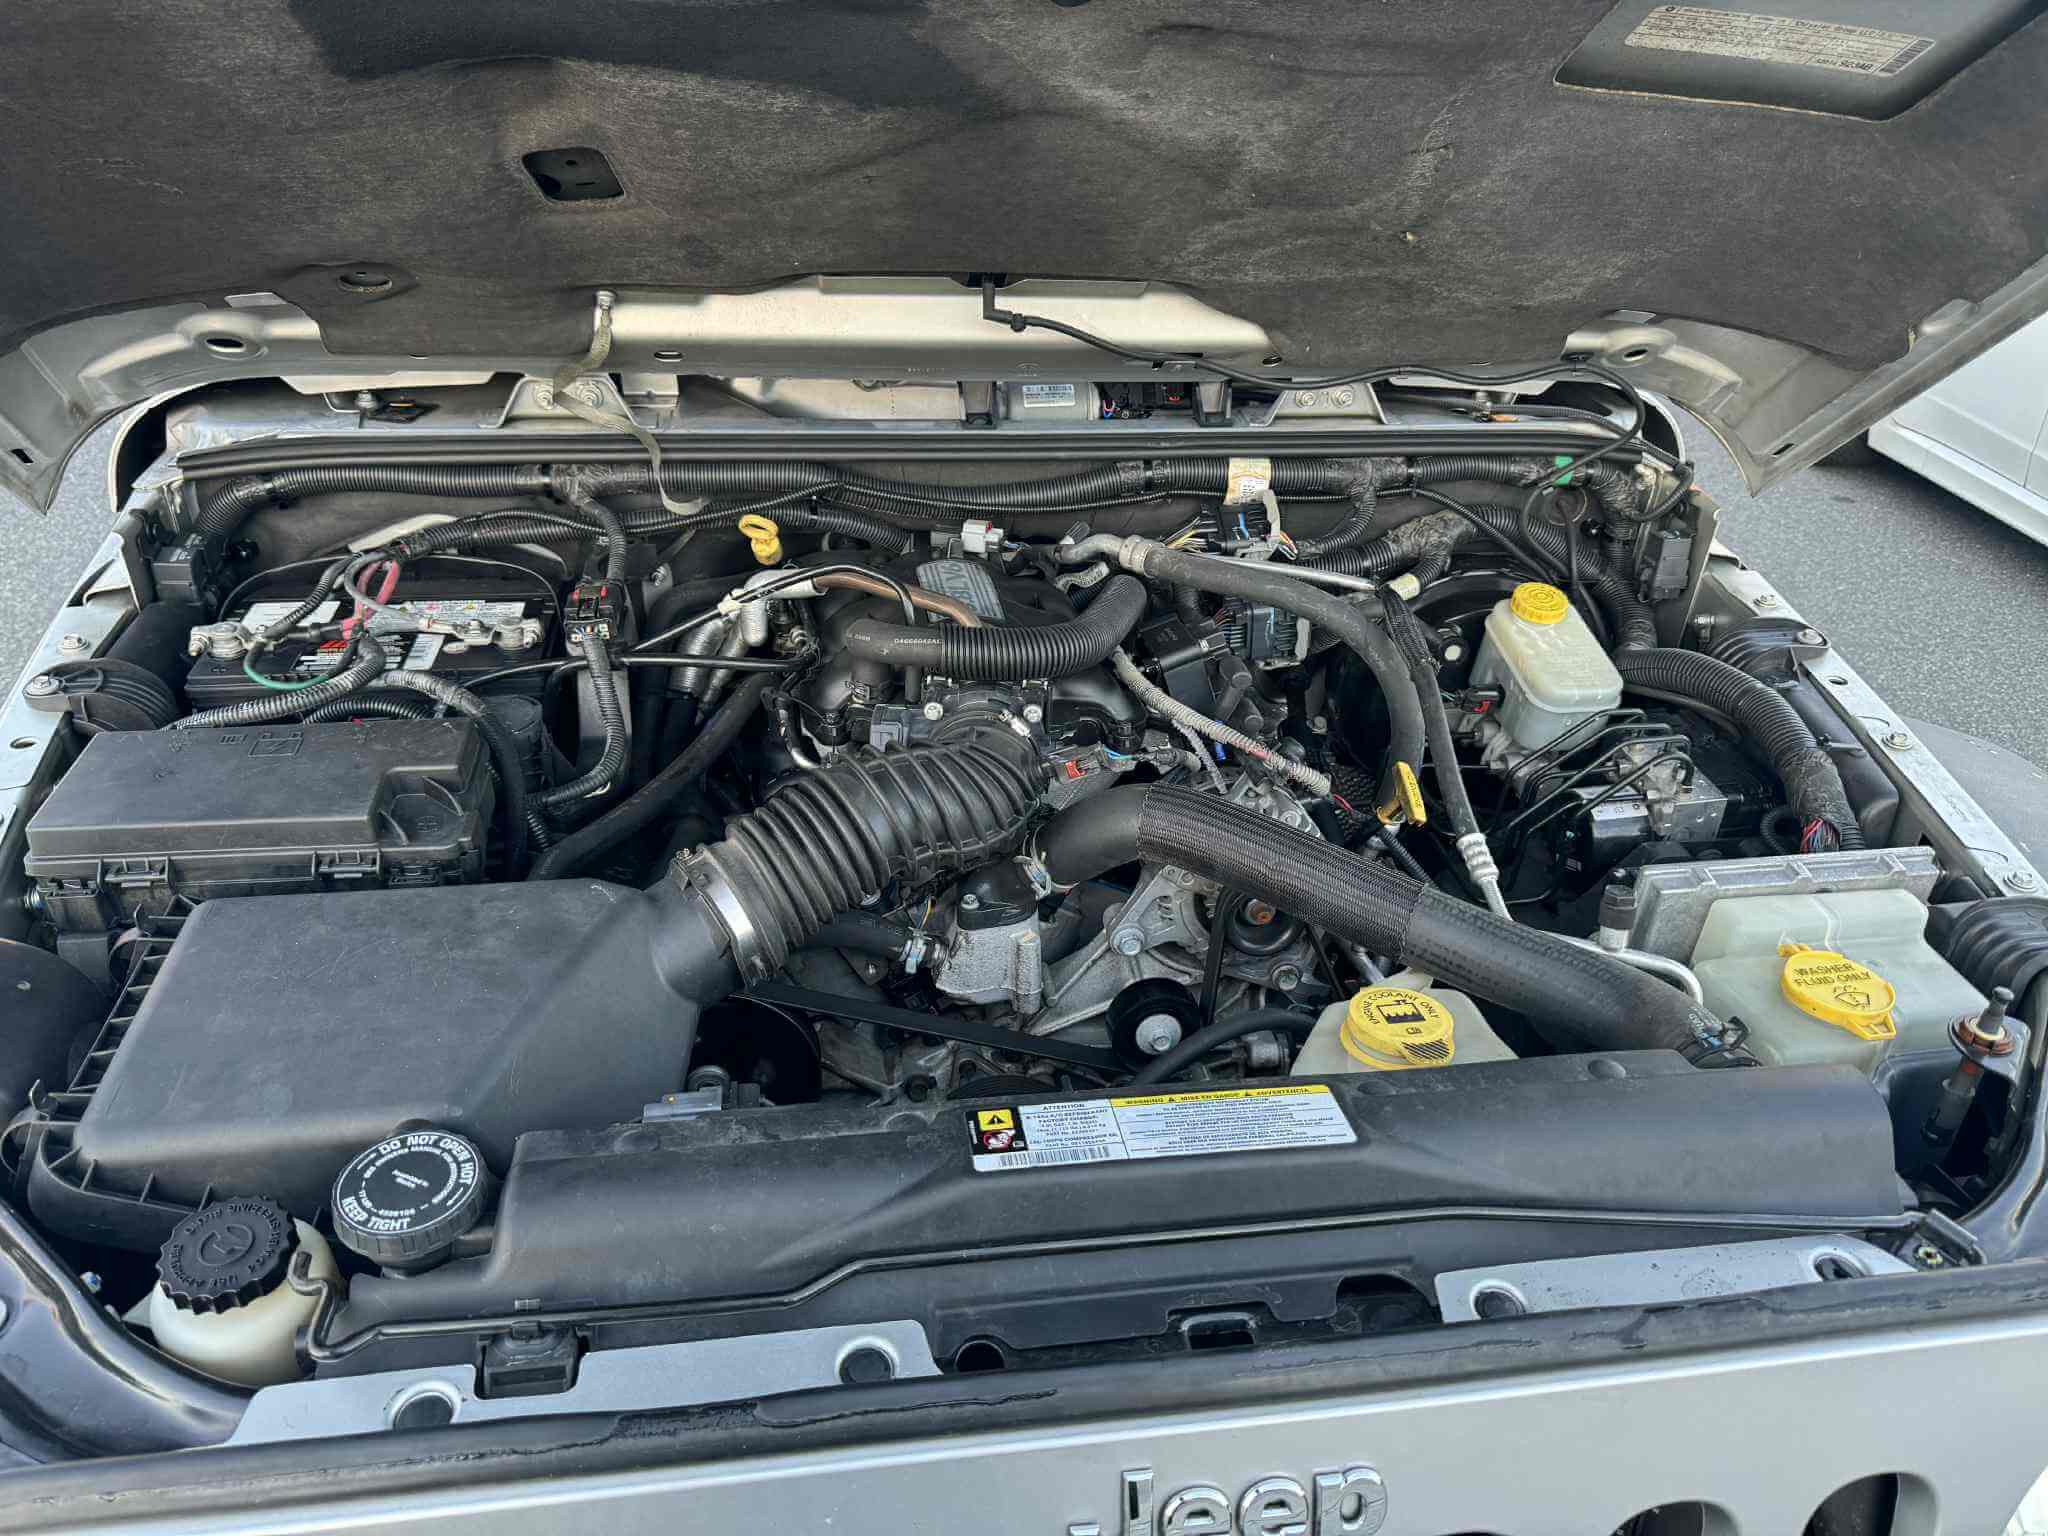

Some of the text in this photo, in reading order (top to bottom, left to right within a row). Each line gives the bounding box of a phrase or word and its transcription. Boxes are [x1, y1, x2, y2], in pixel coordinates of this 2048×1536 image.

[1794, 962, 1856, 976] WASHER
[1795, 971, 1872, 986] FLUID ONLY
[378, 1140, 401, 1154] DO
[406, 1135, 438, 1146] NOT
[439, 1138, 472, 1161] OPEN
[459, 1161, 474, 1185] HOT
[342, 1196, 411, 1231] KEEP TIGHT
[1068, 1464, 1388, 1536] Jeep
